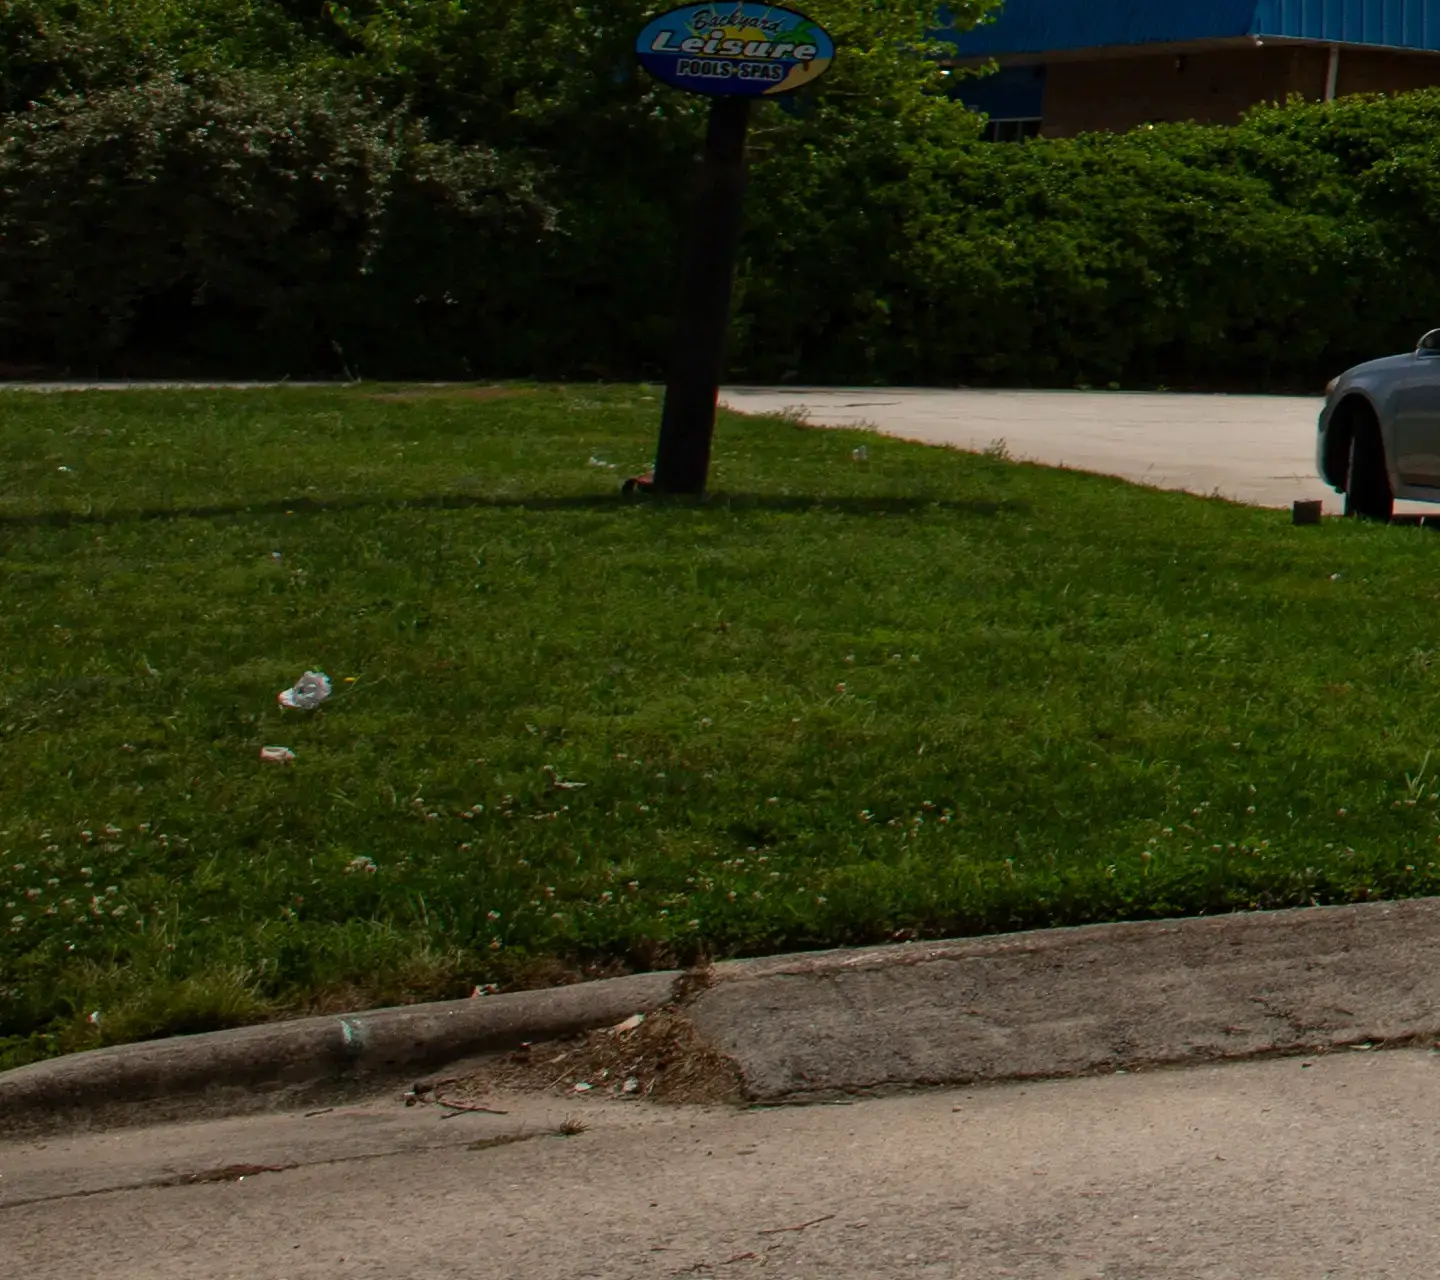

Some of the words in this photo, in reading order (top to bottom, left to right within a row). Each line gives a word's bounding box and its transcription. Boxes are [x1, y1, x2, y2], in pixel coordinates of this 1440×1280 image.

[691, 8, 784, 34] Backyard
[651, 29, 818, 60] Leisure
[677, 58, 731, 77] POOLS
[738, 62, 783, 81] SPAS
